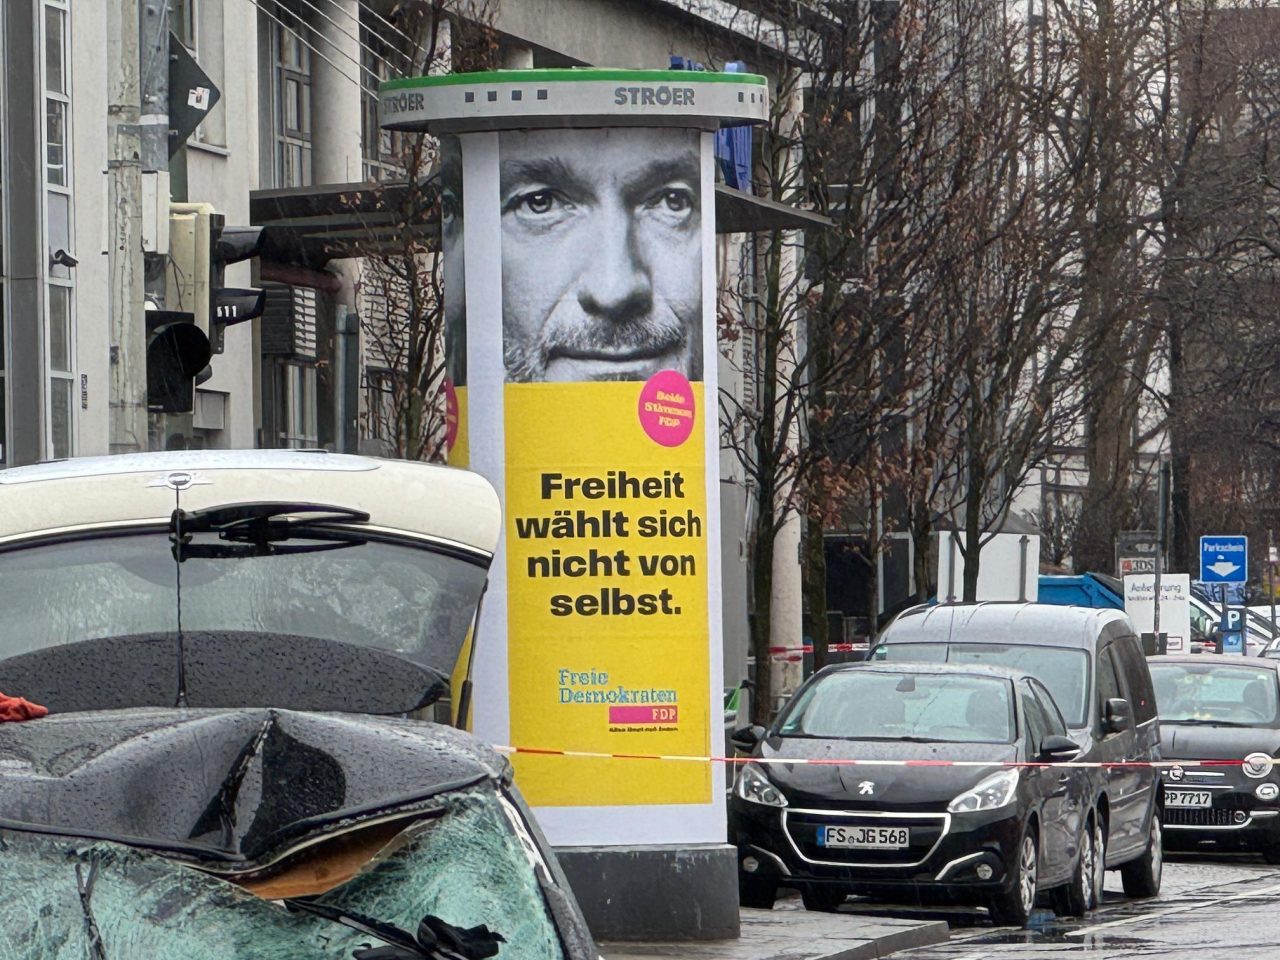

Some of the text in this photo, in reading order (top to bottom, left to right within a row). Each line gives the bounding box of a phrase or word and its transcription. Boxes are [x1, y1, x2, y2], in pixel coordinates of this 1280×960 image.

[541, 471, 685, 499] Freiheit
[516, 510, 702, 539] wählt sich
[527, 549, 695, 577] nicht von
[550, 588, 682, 616] selbst.
[1227, 611, 1240, 628] P
[559, 668, 609, 685] Freie
[559, 686, 677, 703] Demokraten
[652, 708, 676, 720] FDP
[1180, 792, 1210, 805] 7717
[825, 829, 907, 844] FS JG 568
